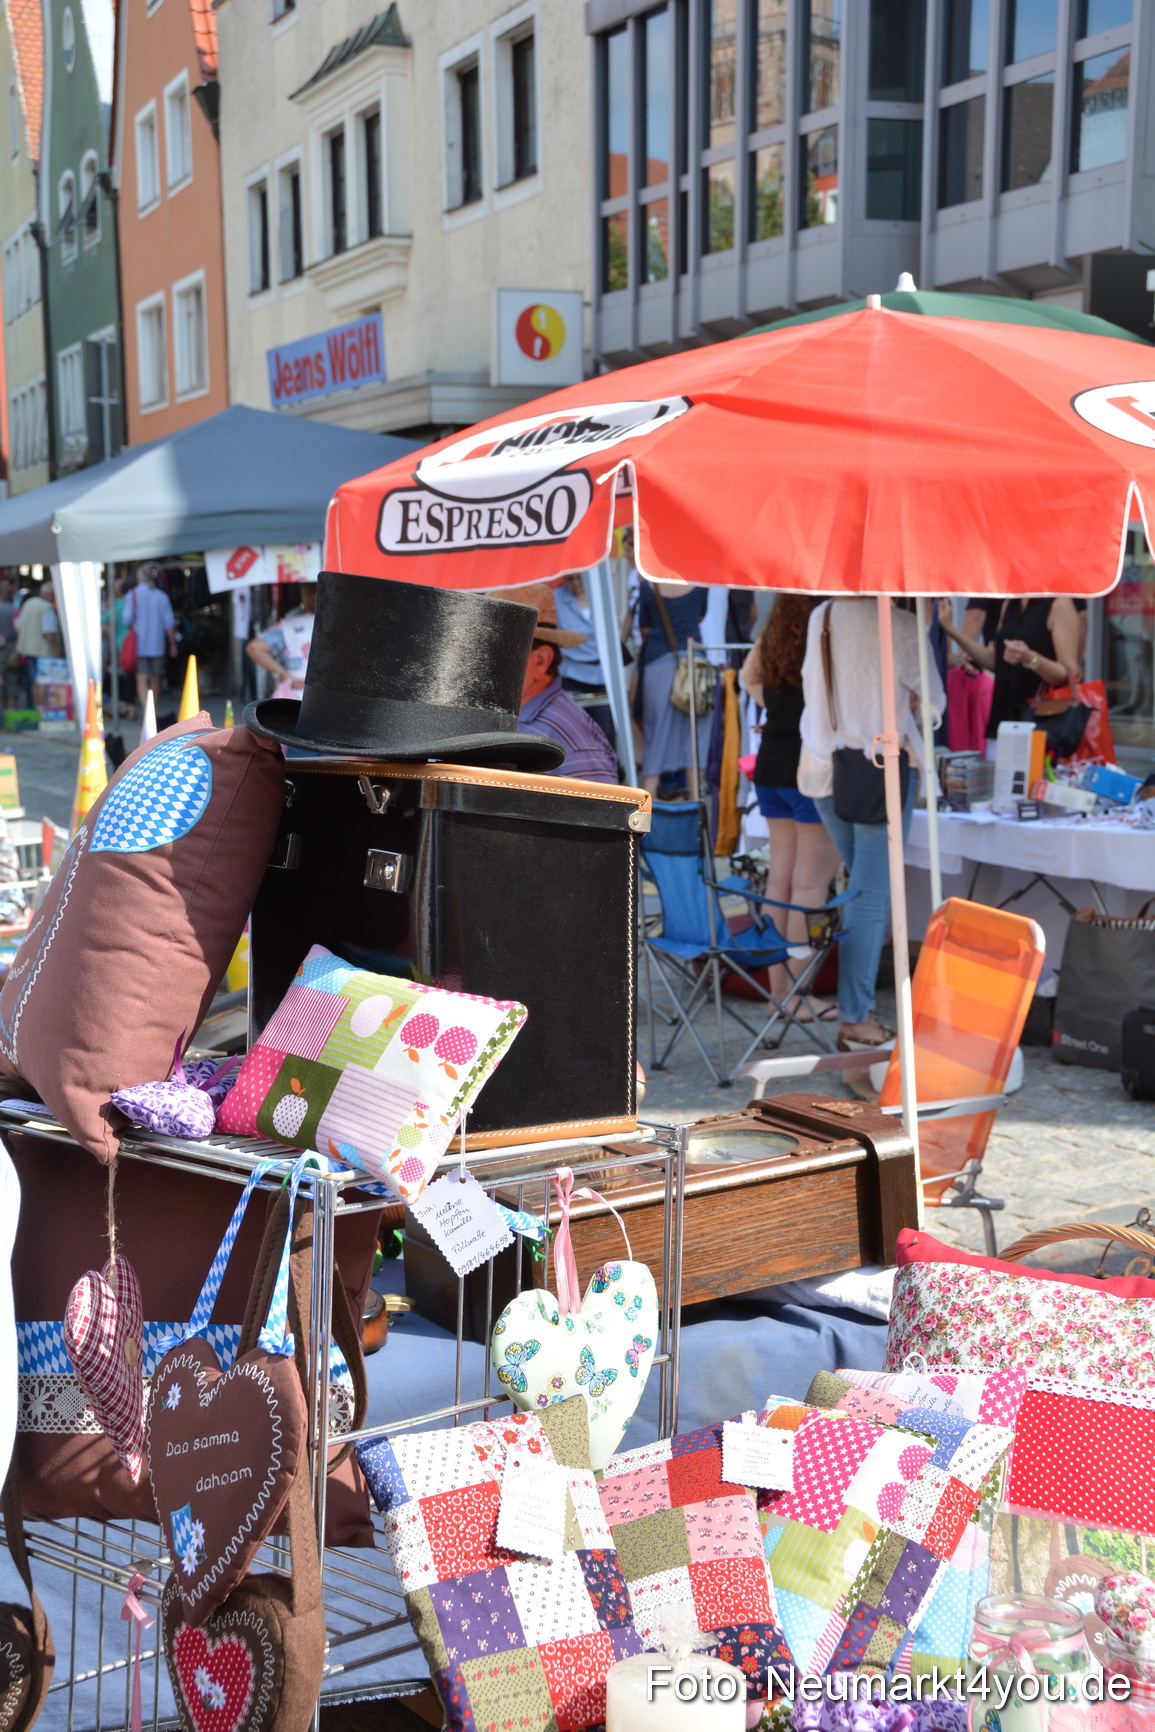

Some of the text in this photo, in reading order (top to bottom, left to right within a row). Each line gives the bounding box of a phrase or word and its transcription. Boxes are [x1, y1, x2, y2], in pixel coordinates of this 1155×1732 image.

[272, 352, 327, 400] Jeans
[395, 485, 577, 544] ESPRESSO
[439, 1208, 471, 1229] Hopfen
[193, 1430, 240, 1450] samma
[195, 1466, 252, 1492] dahoam
